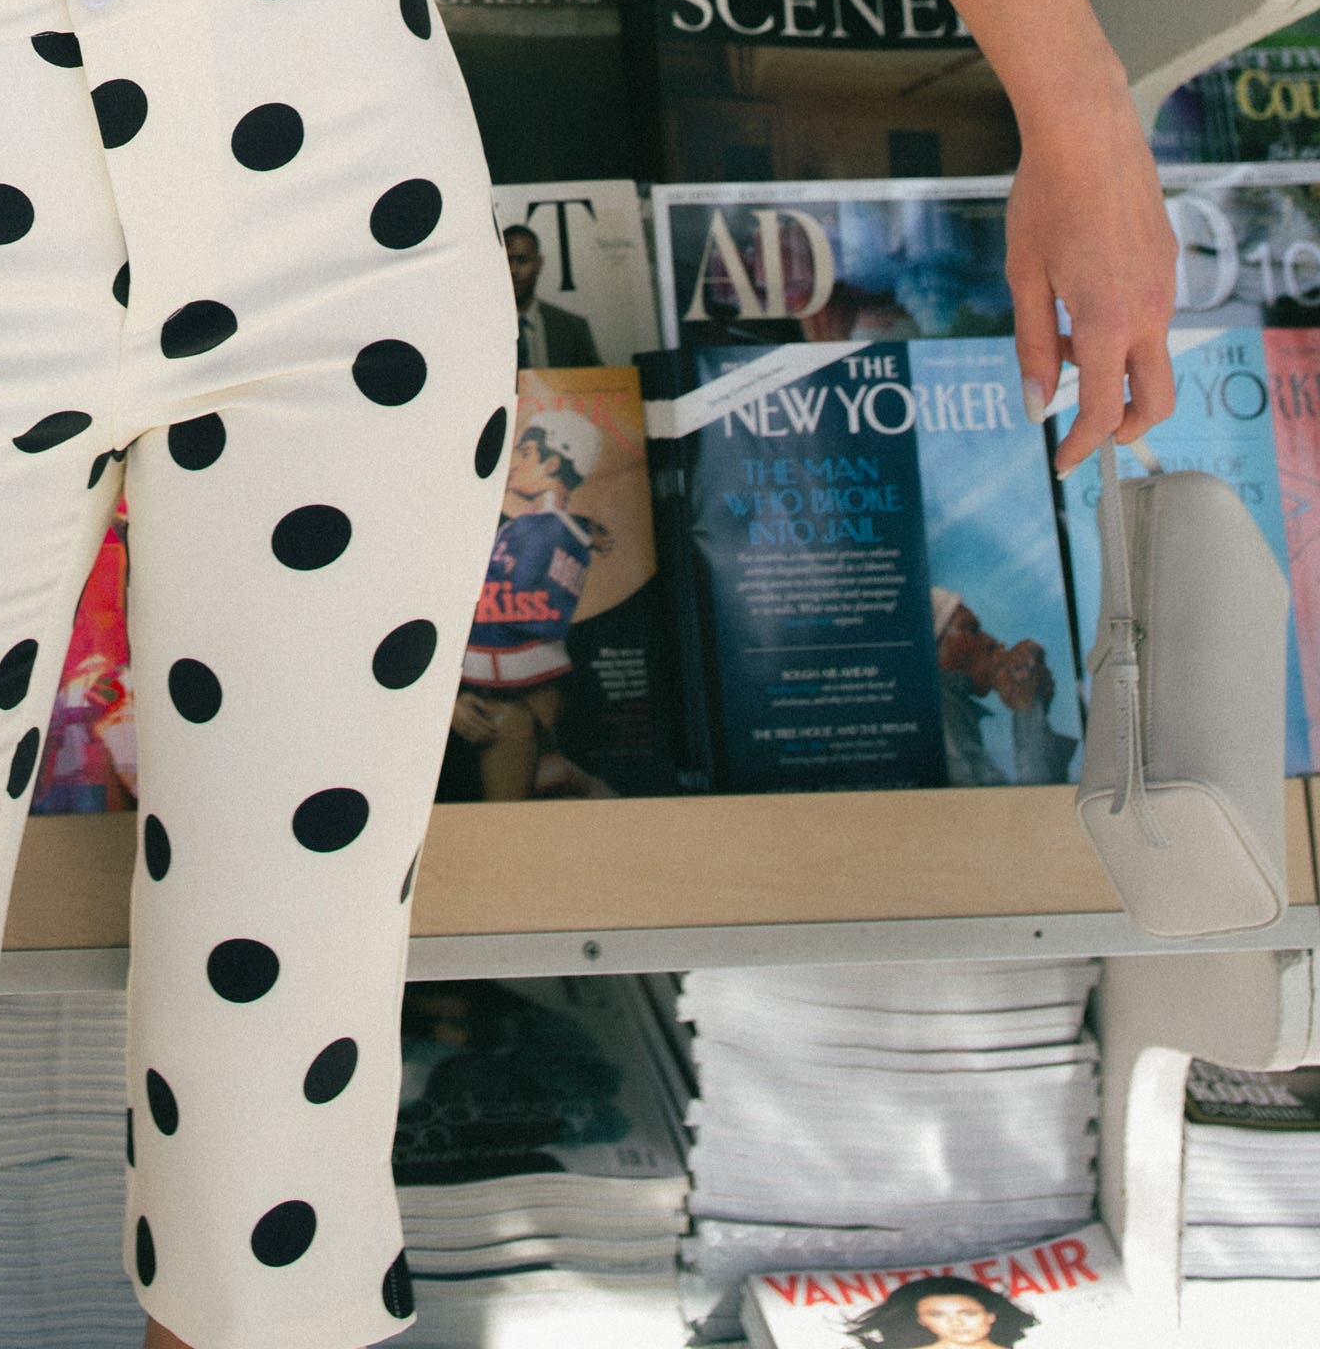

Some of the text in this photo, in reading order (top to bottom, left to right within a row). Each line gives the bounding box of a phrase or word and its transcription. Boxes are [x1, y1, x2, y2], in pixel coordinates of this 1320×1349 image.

[684, 206, 836, 322] AD
[844, 355, 899, 380] THE
[835, 381, 1016, 436] YORKER
[474, 579, 562, 624] Kiss.
[980, 1236, 1101, 1300] FAIR
